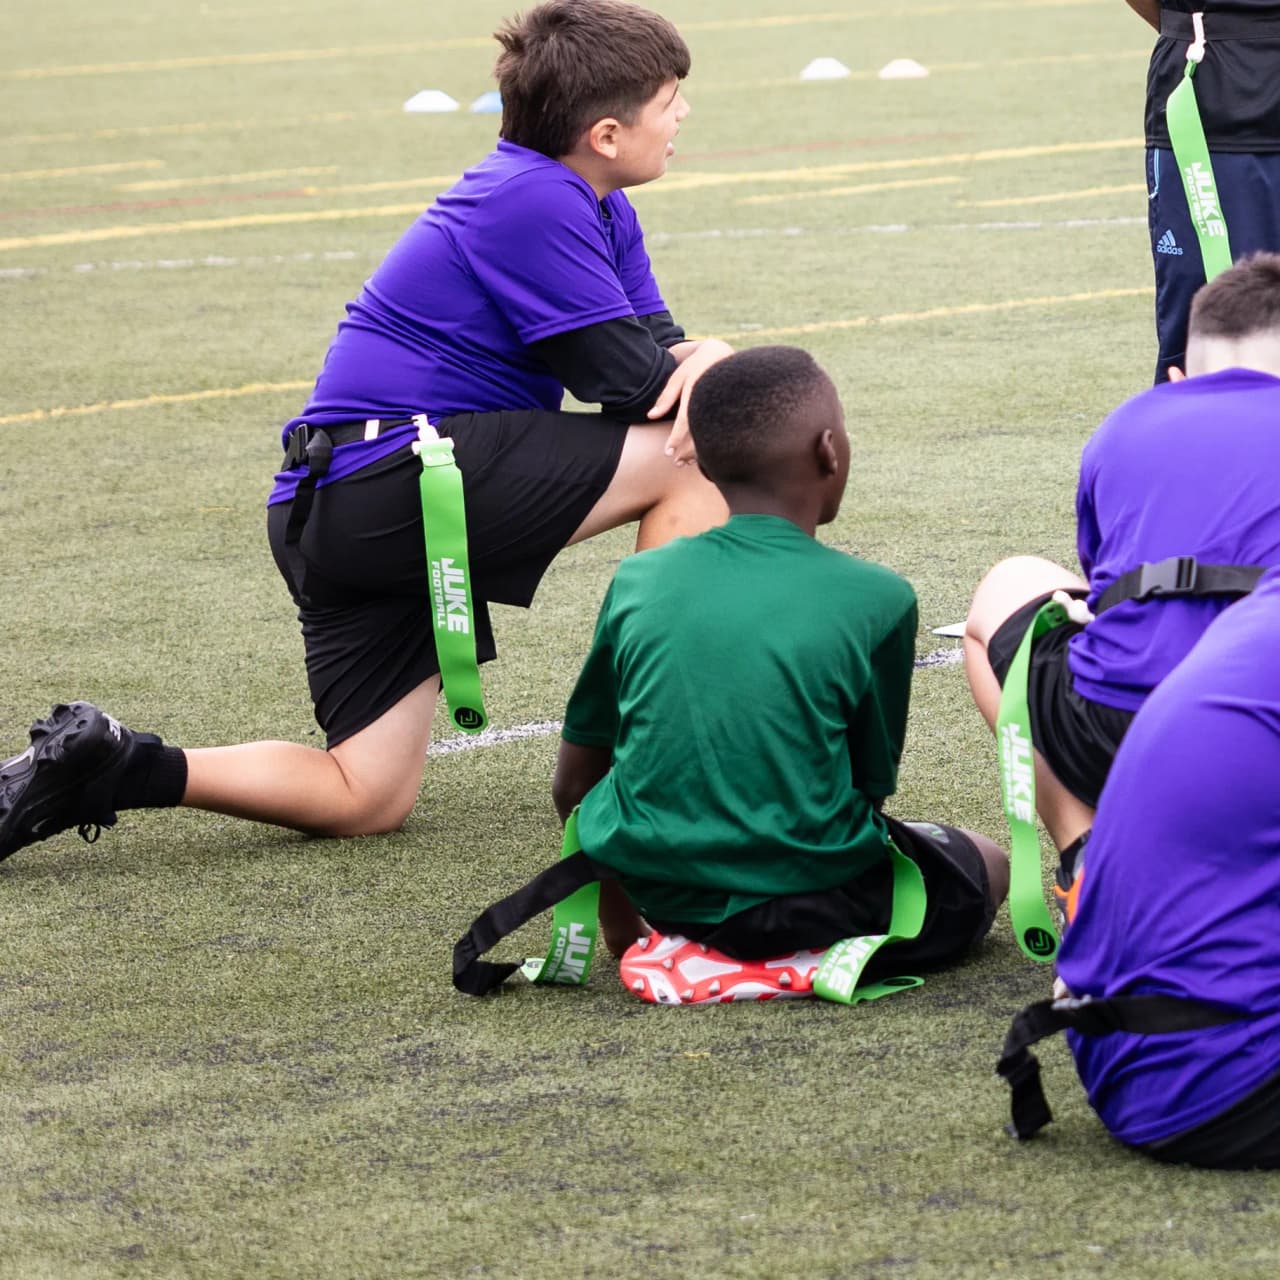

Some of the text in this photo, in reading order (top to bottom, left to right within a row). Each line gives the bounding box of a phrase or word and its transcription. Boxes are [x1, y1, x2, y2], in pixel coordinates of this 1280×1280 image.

[1192, 162, 1224, 237] JUKE
[1156, 244, 1184, 256] adidas
[431, 561, 447, 628] FOOTBALL
[441, 557, 469, 634] JUKE
[1008, 723, 1032, 824] JUKE
[555, 923, 591, 983] JUK
[827, 934, 883, 996] UKE
